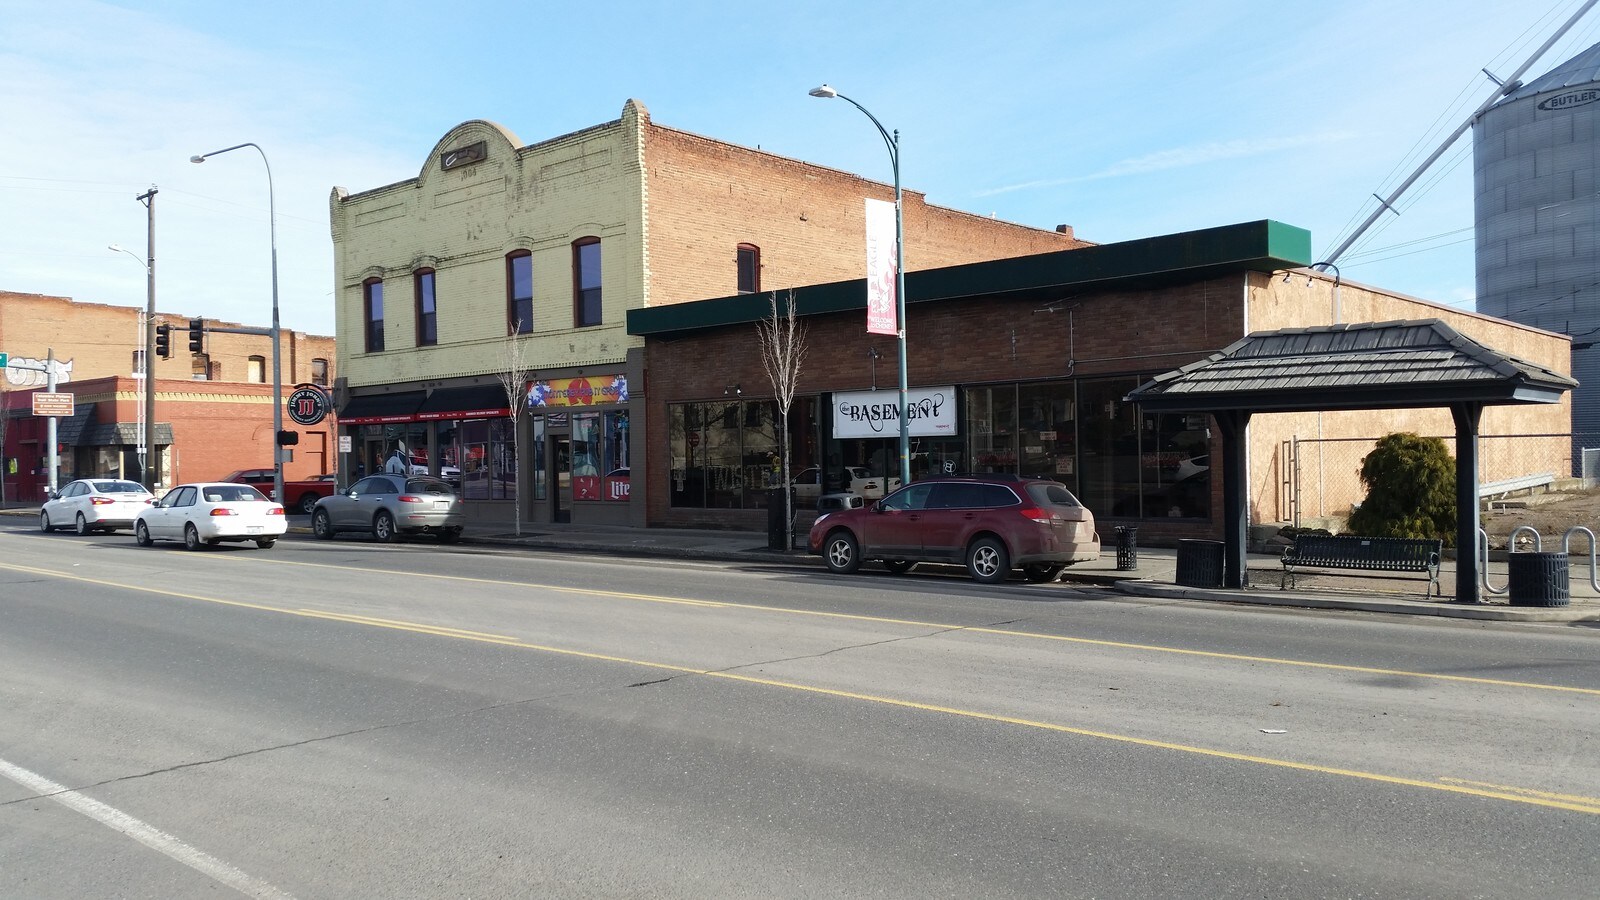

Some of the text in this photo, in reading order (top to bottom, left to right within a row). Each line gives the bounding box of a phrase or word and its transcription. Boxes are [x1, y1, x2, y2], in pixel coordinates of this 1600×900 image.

[1551, 92, 1596, 107] BUTLER
[290, 391, 305, 407] JIMMY
[298, 399, 315, 416] JJ
[611, 481, 630, 500] Lite
